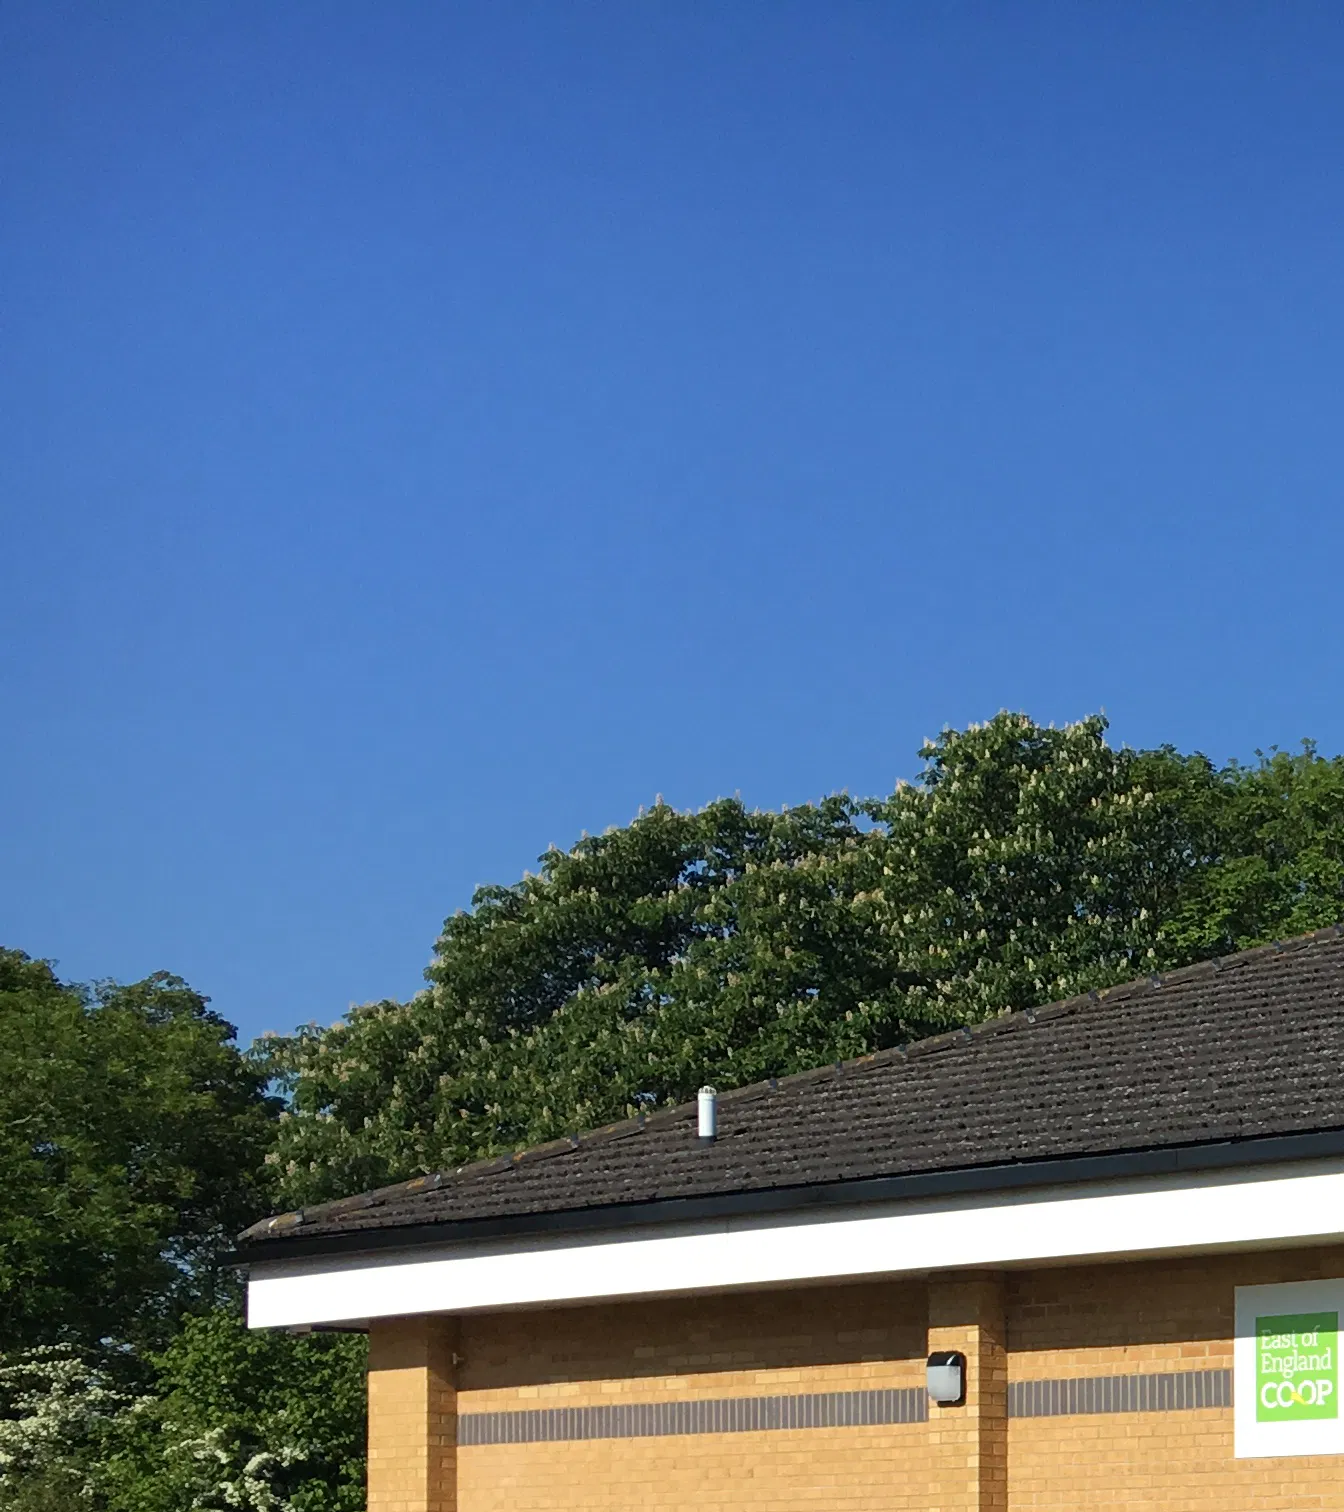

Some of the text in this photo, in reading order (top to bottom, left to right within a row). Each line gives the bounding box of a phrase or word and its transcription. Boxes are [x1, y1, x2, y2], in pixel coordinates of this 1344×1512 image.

[1261, 1325, 1320, 1350] East of
[1261, 1347, 1333, 1378] England
